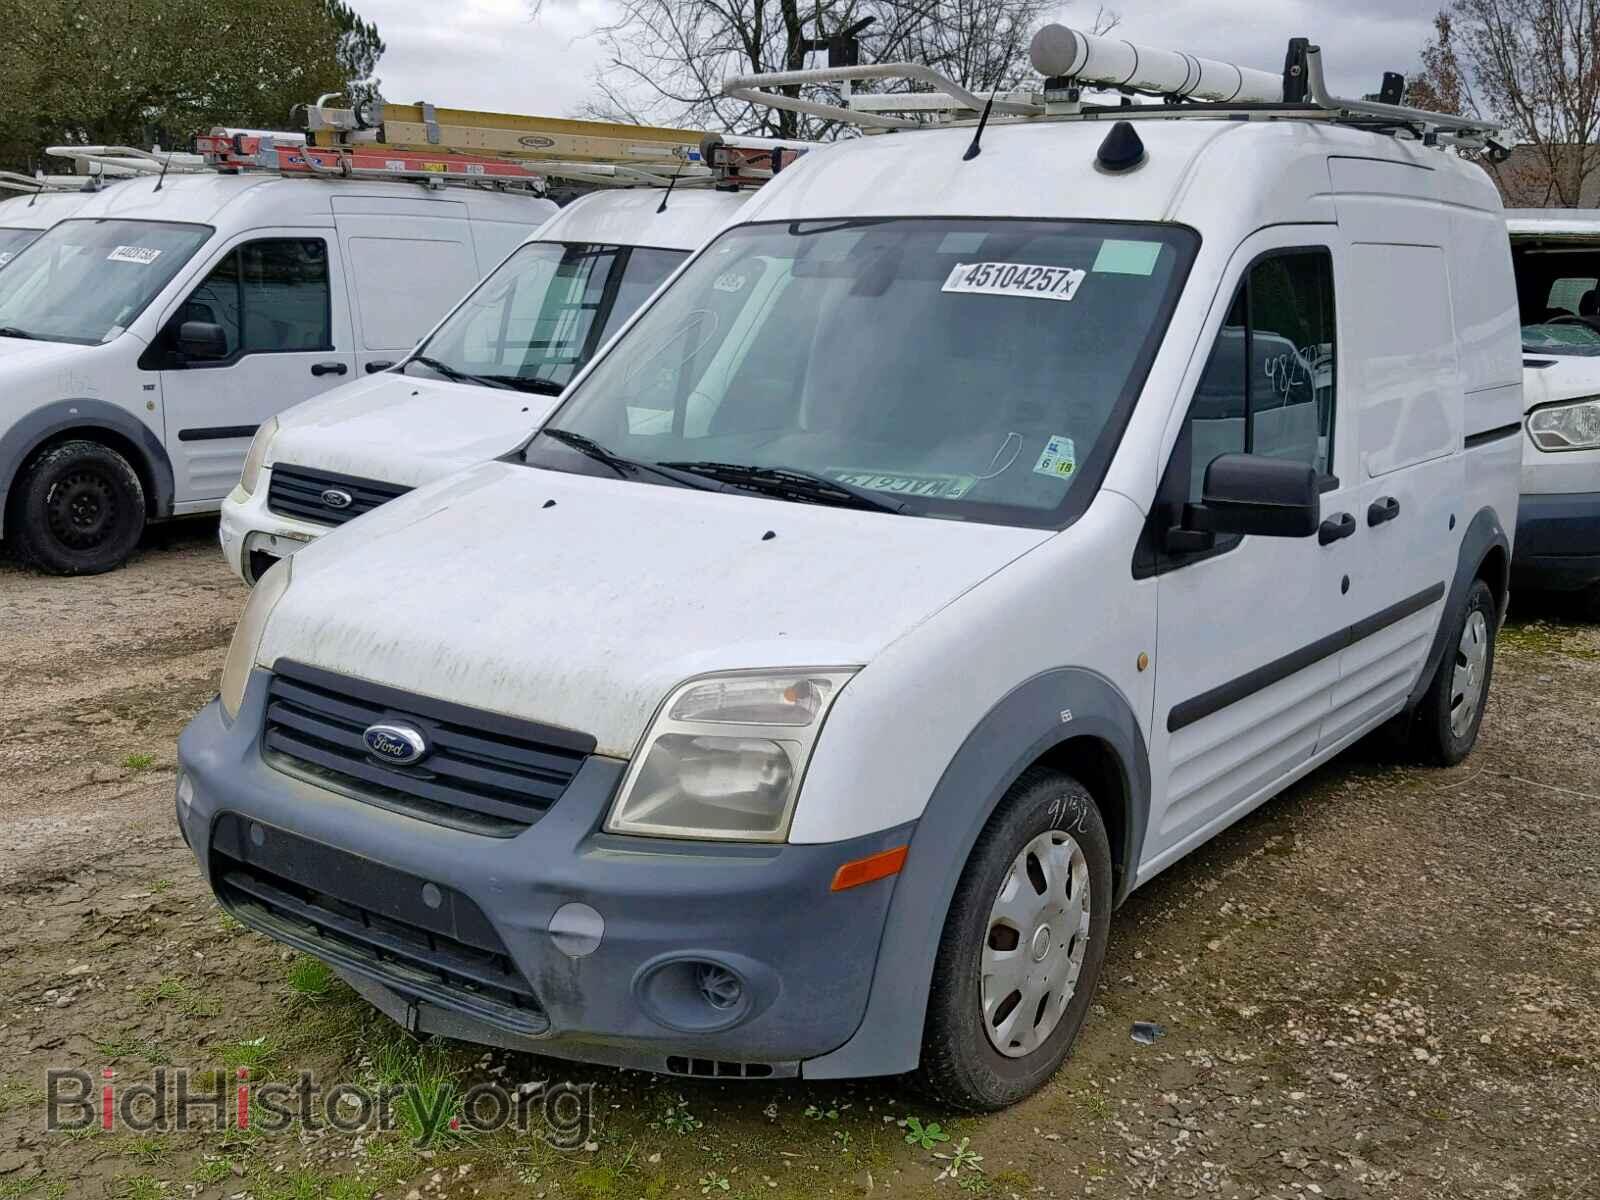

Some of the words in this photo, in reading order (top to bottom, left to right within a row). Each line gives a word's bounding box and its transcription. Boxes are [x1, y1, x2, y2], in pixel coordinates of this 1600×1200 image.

[965, 264, 1071, 292] 45104257
[1042, 458, 1052, 468] 6
[1060, 462, 1073, 473] 18
[373, 732, 406, 756] Ford
